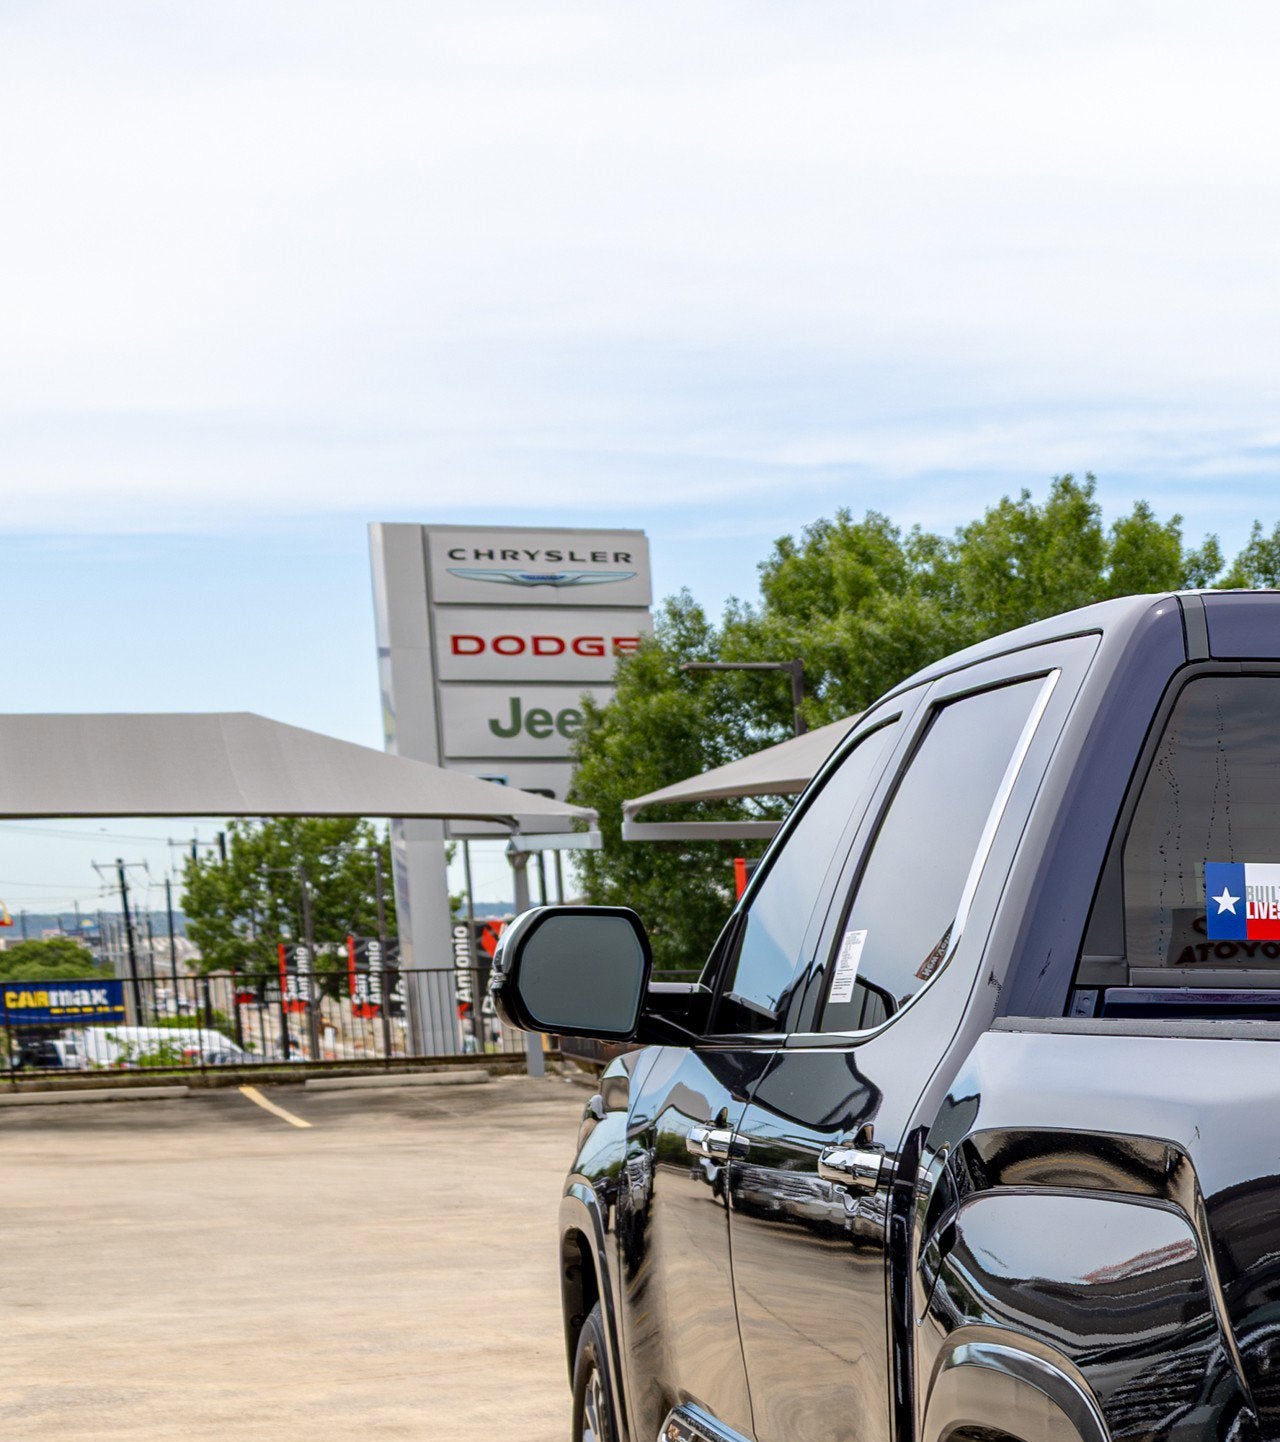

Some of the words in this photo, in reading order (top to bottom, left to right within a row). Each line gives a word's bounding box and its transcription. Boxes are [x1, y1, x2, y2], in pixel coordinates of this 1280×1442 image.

[447, 548, 633, 564] CHRYSLER
[450, 634, 642, 657] DODGE
[488, 697, 586, 739] Jee
[451, 925, 472, 1003] Antonio
